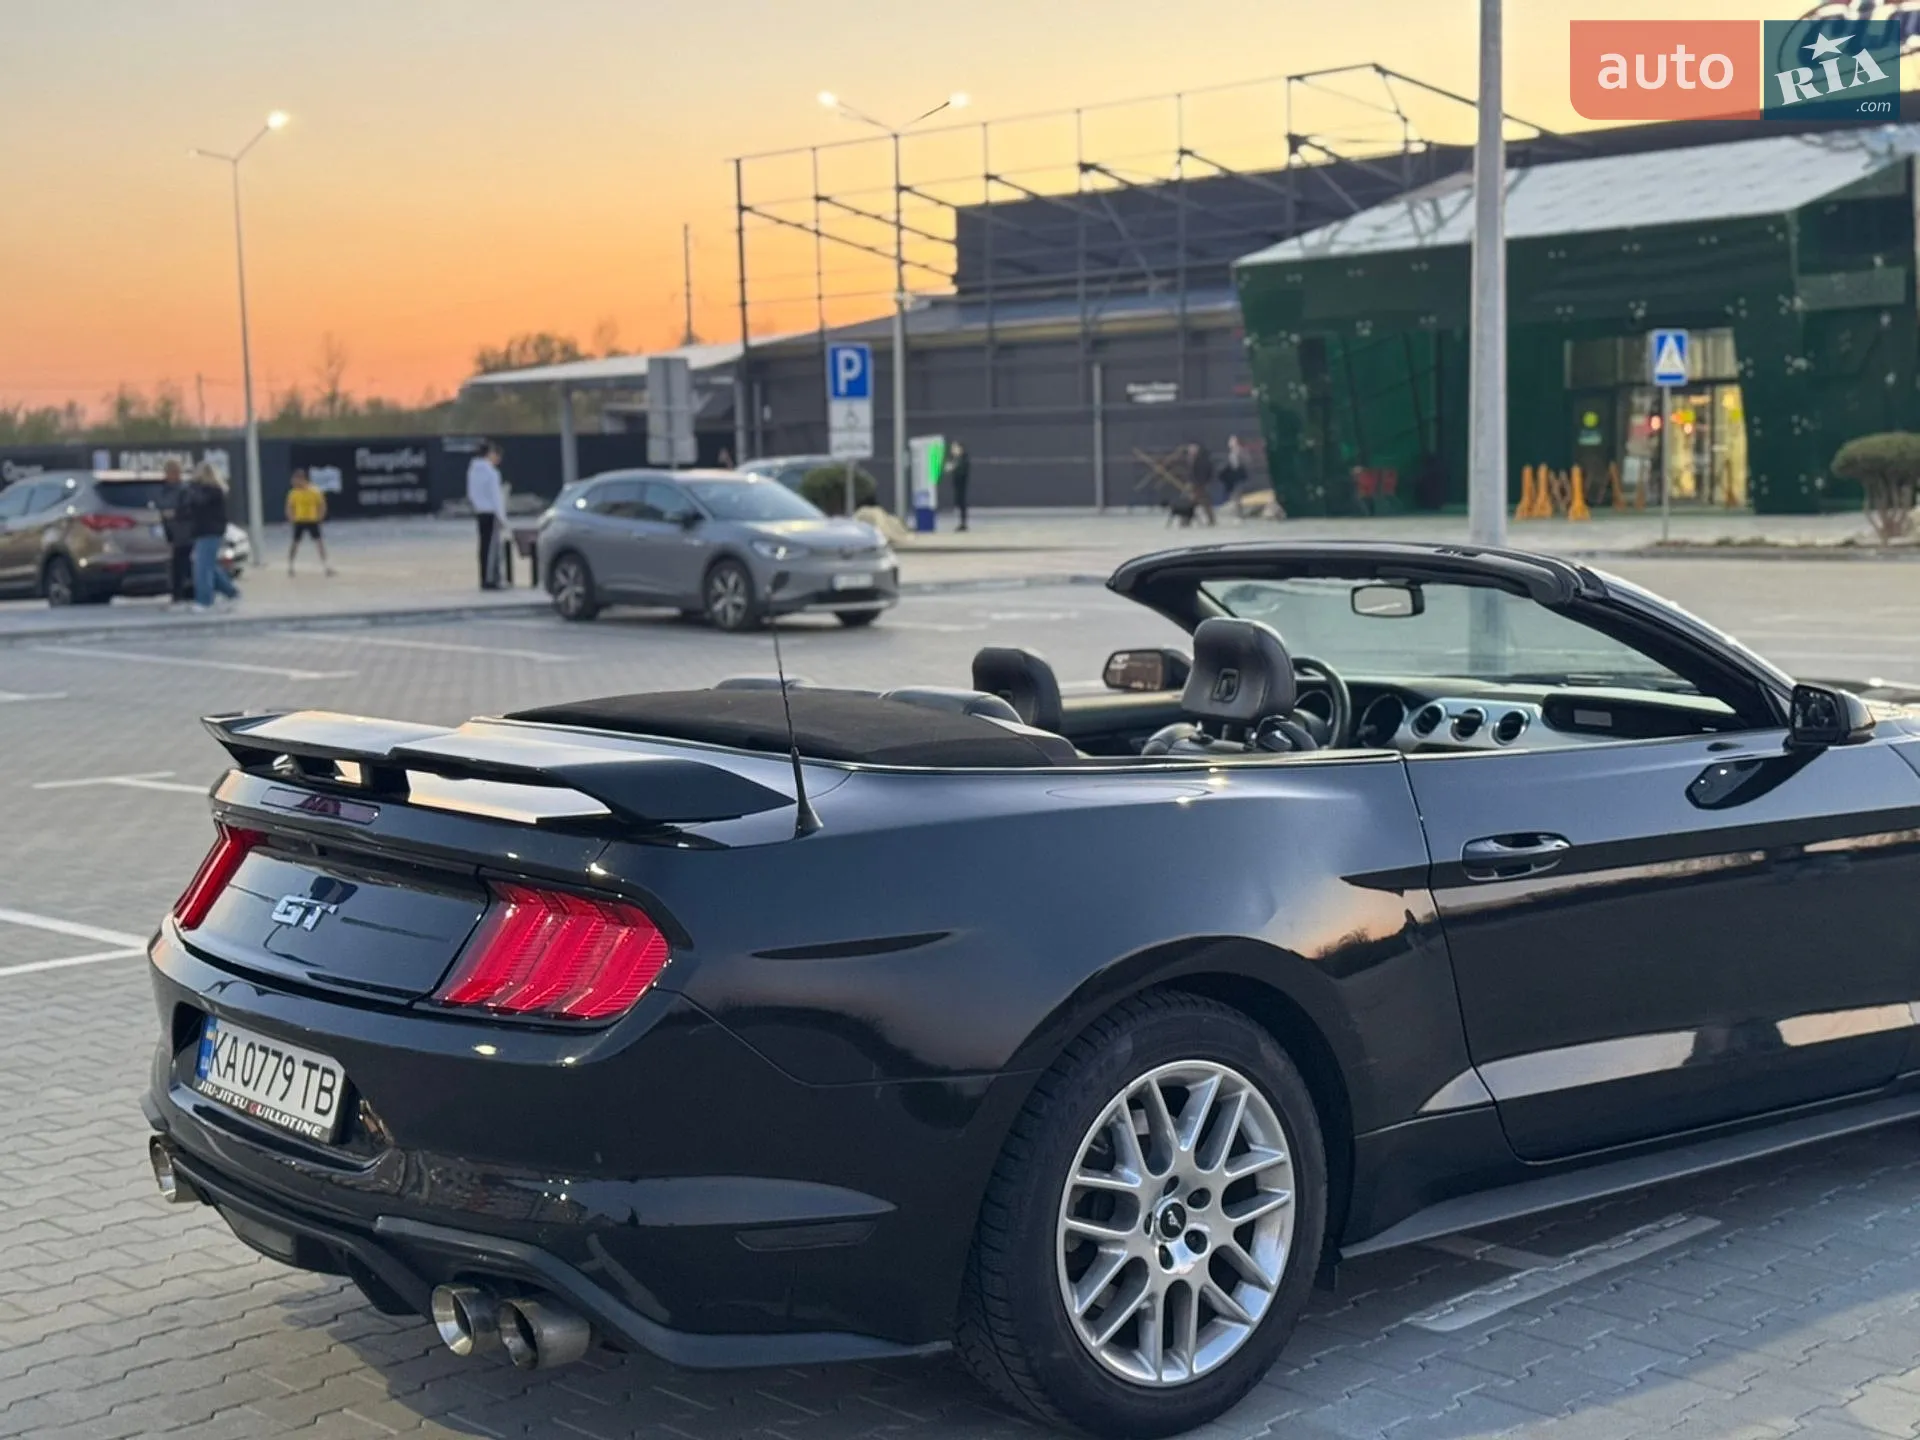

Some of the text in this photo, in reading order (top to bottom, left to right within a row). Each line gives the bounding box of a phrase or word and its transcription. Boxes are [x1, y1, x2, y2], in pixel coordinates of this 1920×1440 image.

[837, 349, 862, 396] P
[271, 894, 338, 932] GT
[198, 1080, 248, 1110] JIU-JITSU
